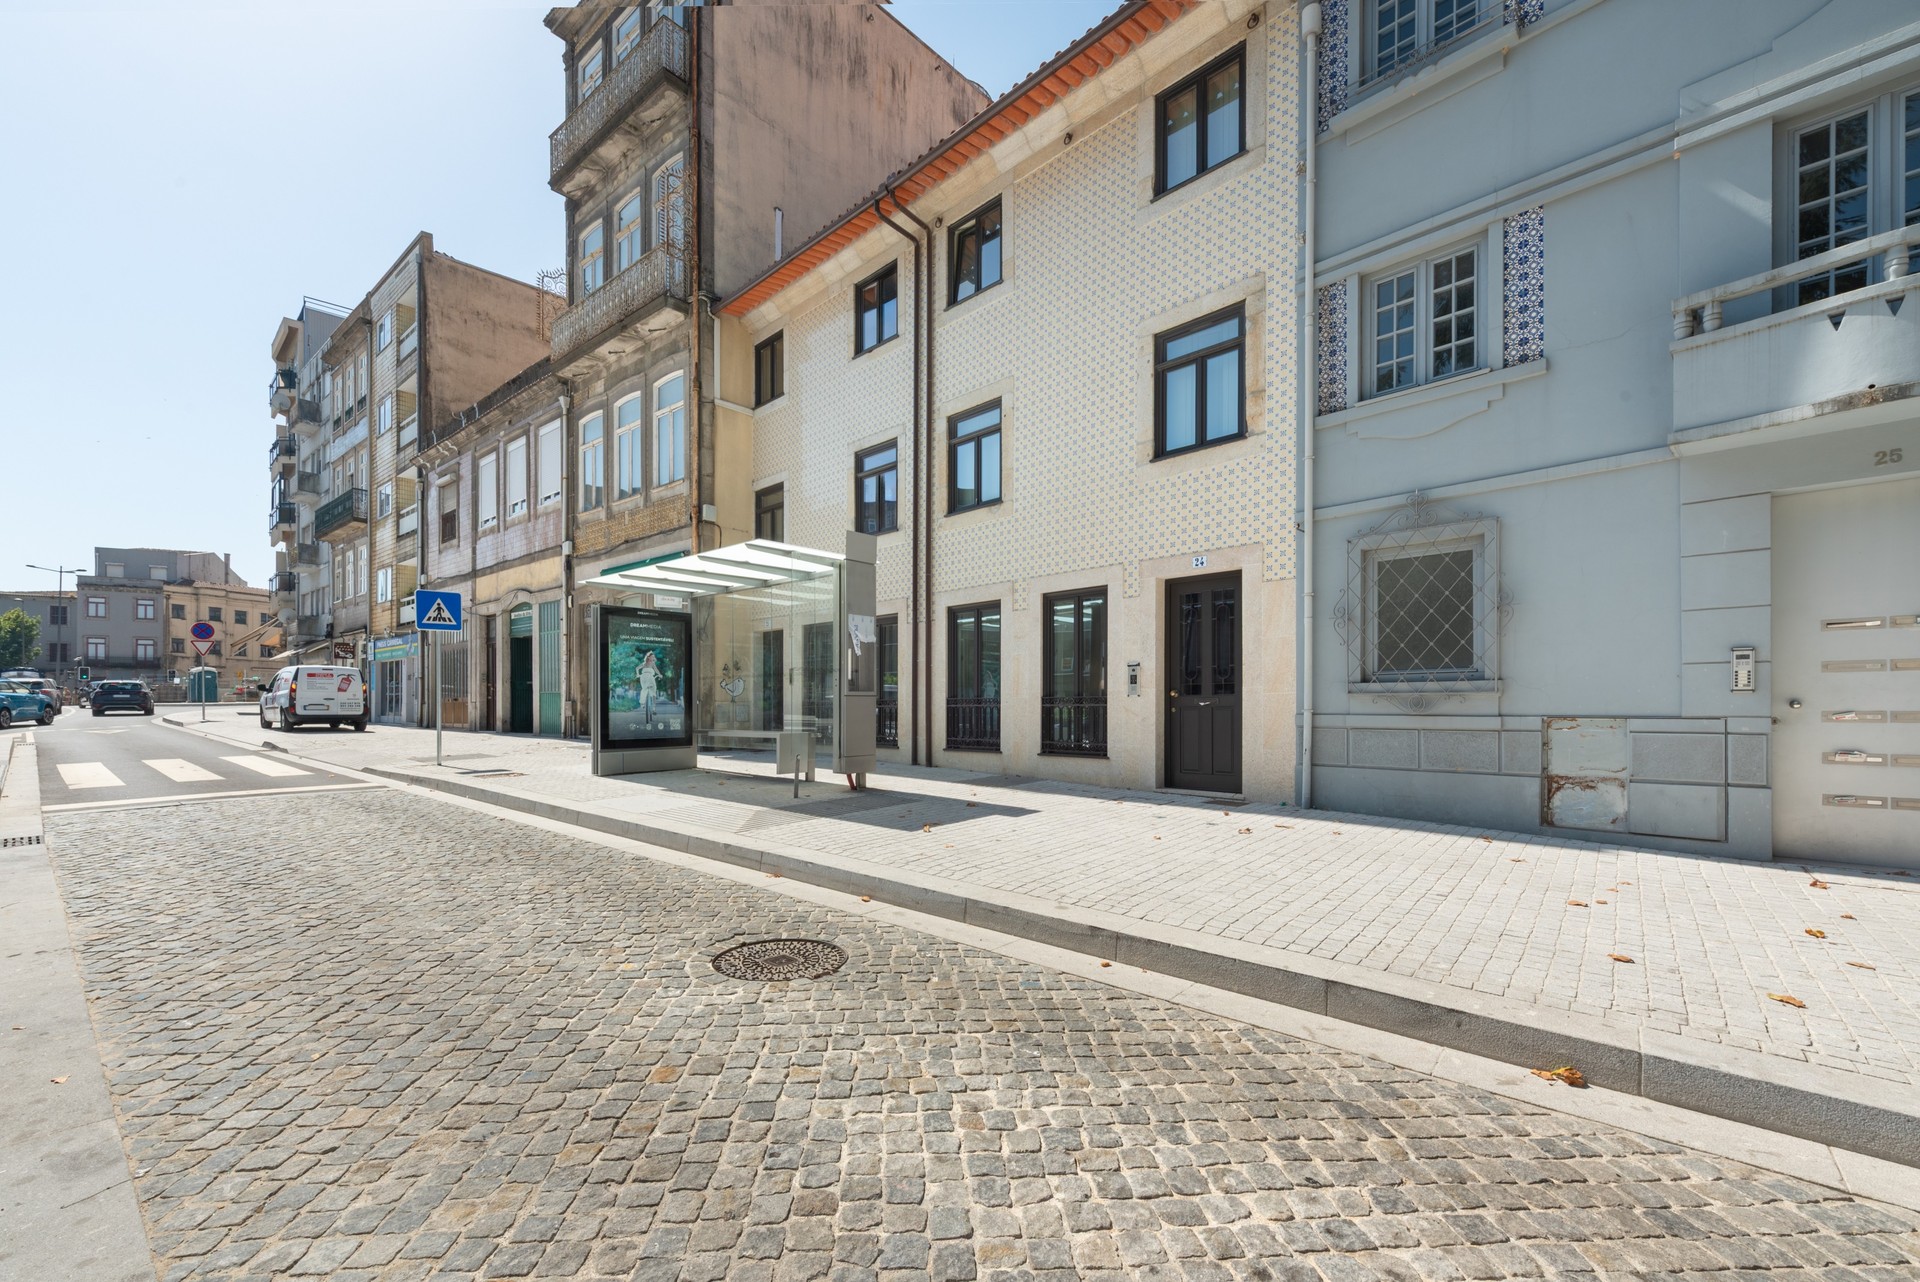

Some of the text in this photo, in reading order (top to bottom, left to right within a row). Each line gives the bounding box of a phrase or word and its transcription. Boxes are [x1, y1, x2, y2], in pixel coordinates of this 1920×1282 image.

[1873, 447, 1903, 467] 25
[1194, 556, 1205, 567] 24
[630, 622, 662, 630] DREAMMEDIA
